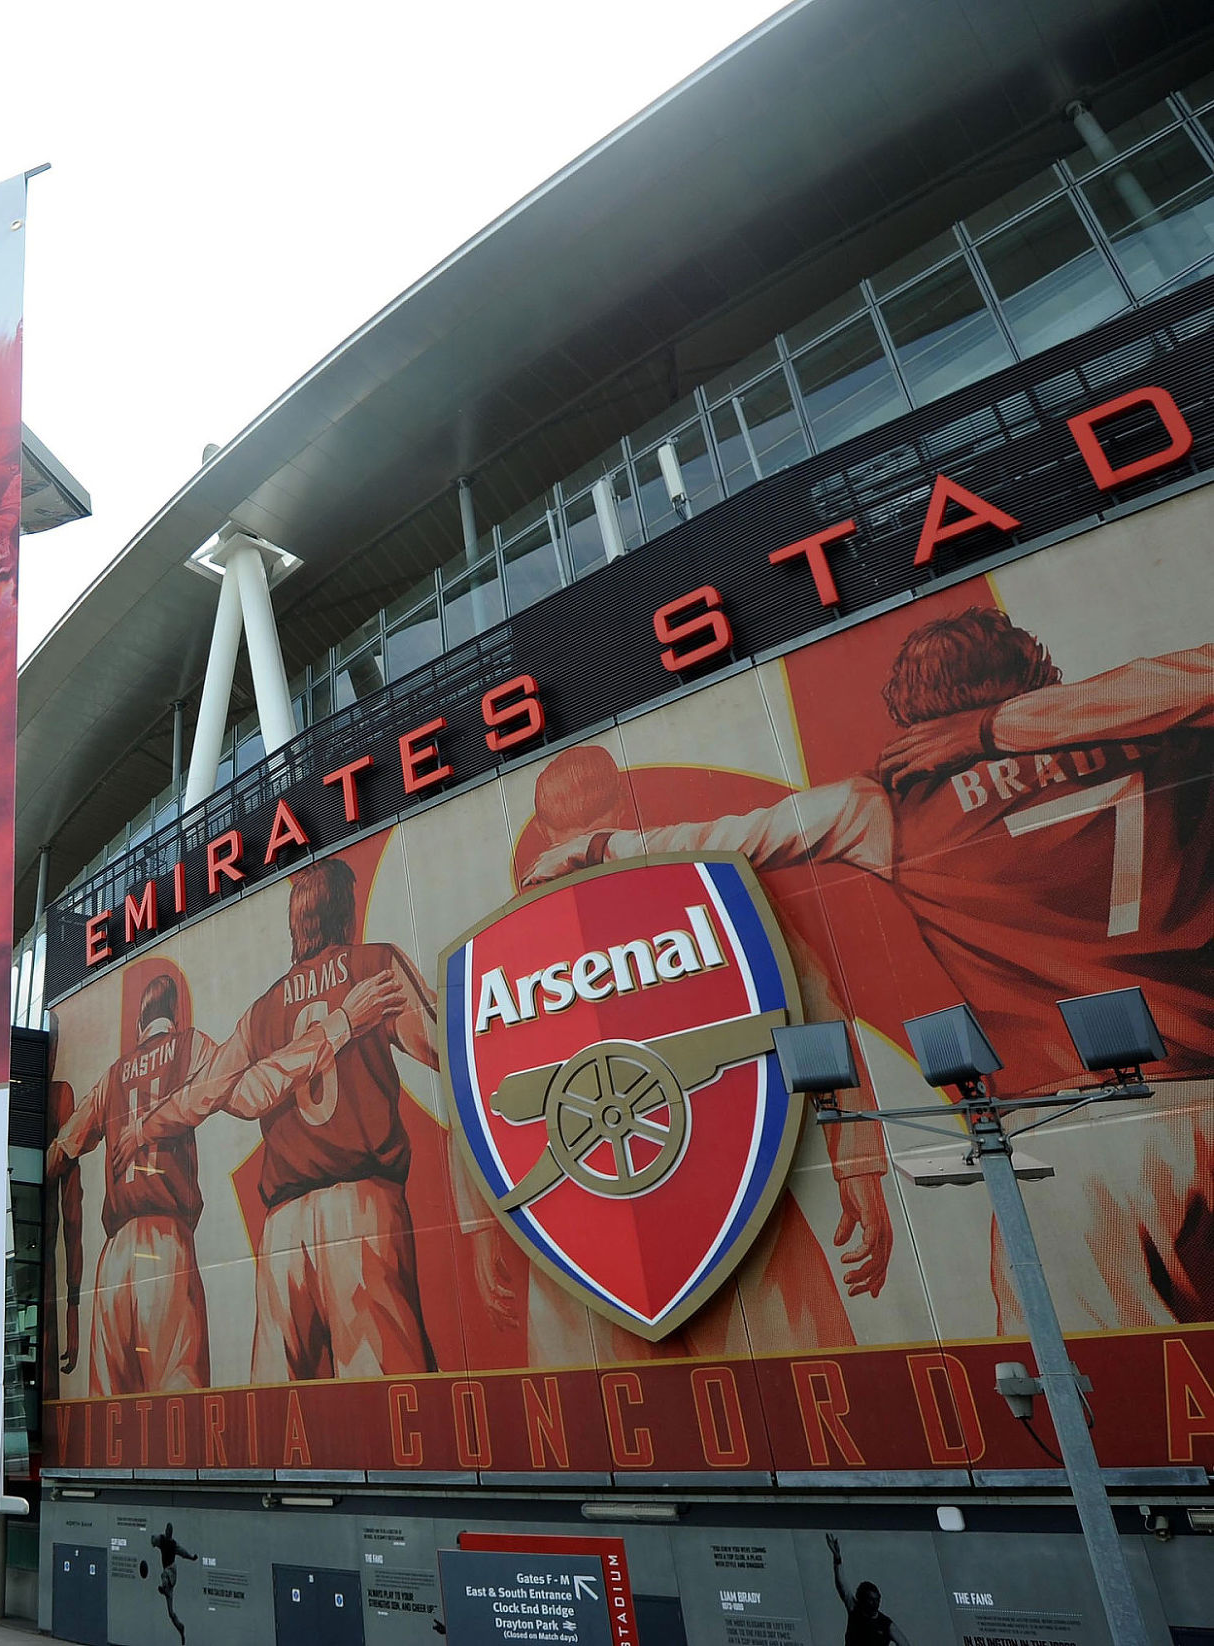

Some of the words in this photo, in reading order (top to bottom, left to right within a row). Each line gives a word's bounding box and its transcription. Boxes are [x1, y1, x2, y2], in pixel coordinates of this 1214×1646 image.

[87, 674, 547, 966] EMIRATES
[654, 386, 1193, 672] STAD
[1003, 772, 1143, 937] 7
[475, 904, 729, 1036] Arsenal
[283, 953, 349, 1007] ADAMS
[122, 1039, 176, 1083] BASTIN
[57, 1389, 312, 1467] VICTORIA
[387, 1339, 1214, 1468] CONCORDA
[517, 1573, 545, 1585] Gates
[546, 1574, 552, 1585] F
[560, 1574, 570, 1586] M
[466, 1586, 487, 1597] East
[488, 1587, 497, 1598] &
[498, 1587, 527, 1599] South
[529, 1589, 572, 1601] Entrance
[719, 1590, 737, 1602] LIAM
[737, 1592, 761, 1604] BRADY
[953, 1592, 971, 1605] THE
[970, 1593, 994, 1606] FANS
[493, 1602, 520, 1614] Clock
[521, 1603, 539, 1615] End
[541, 1604, 574, 1618] Bridge
[495, 1618, 534, 1632] Drayton
[536, 1620, 559, 1631] Park
[503, 1630, 528, 1640] (Closed
[538, 1632, 558, 1641] Match
[559, 1634, 578, 1643] days)
